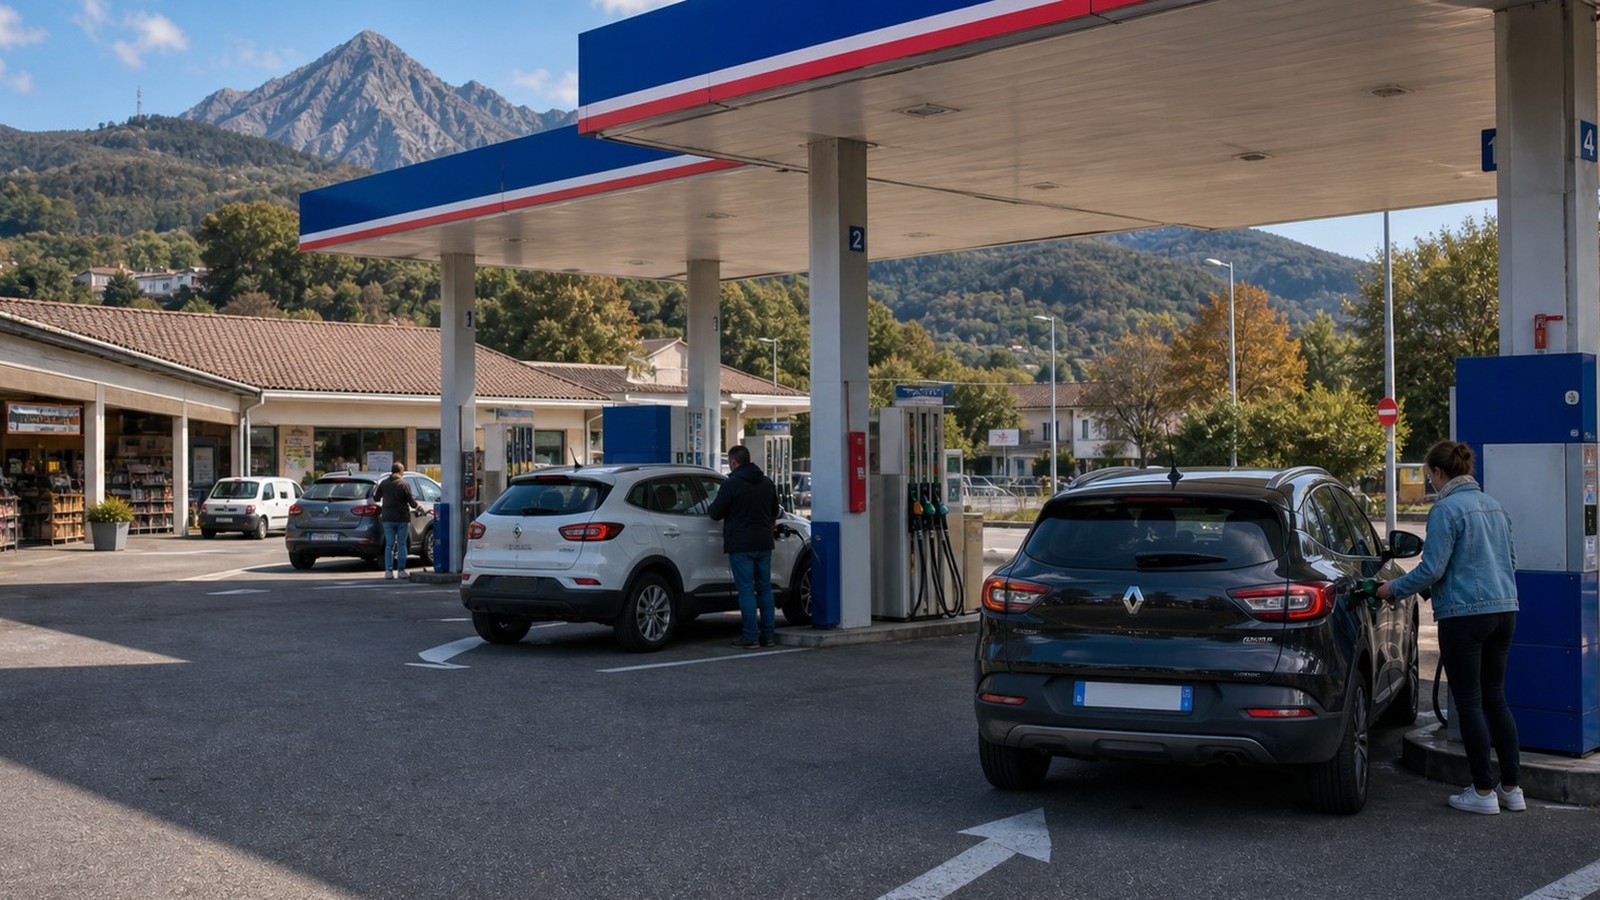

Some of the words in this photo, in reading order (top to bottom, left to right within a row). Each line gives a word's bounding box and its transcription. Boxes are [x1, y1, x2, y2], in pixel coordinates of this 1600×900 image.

[1487, 137, 1497, 164] 1
[1583, 129, 1595, 157] 4
[852, 230, 862, 249] 2
